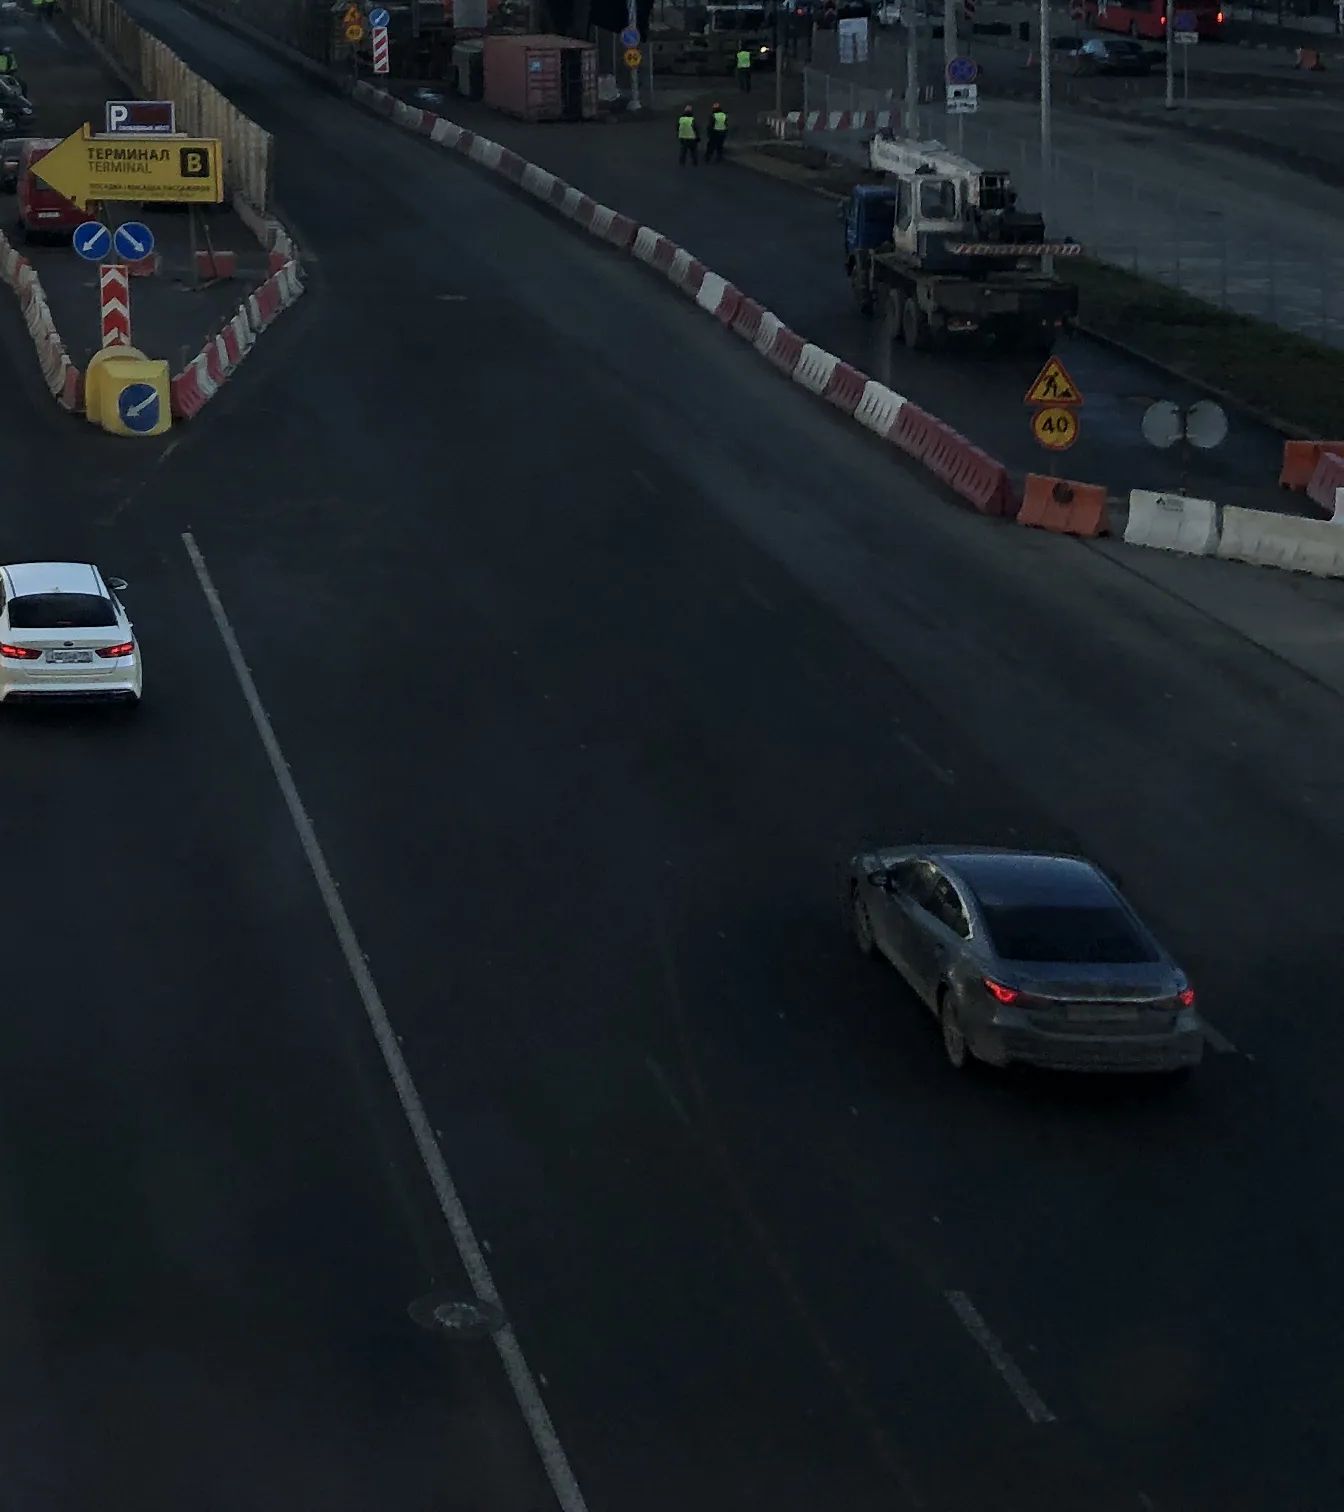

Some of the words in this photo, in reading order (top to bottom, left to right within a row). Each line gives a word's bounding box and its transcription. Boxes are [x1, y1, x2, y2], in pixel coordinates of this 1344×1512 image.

[110, 105, 128, 131] P
[87, 147, 170, 161] ТЕРМИНАЛ
[187, 153, 202, 172] B
[88, 161, 152, 174] TERMINAL
[1042, 416, 1068, 434] 40
